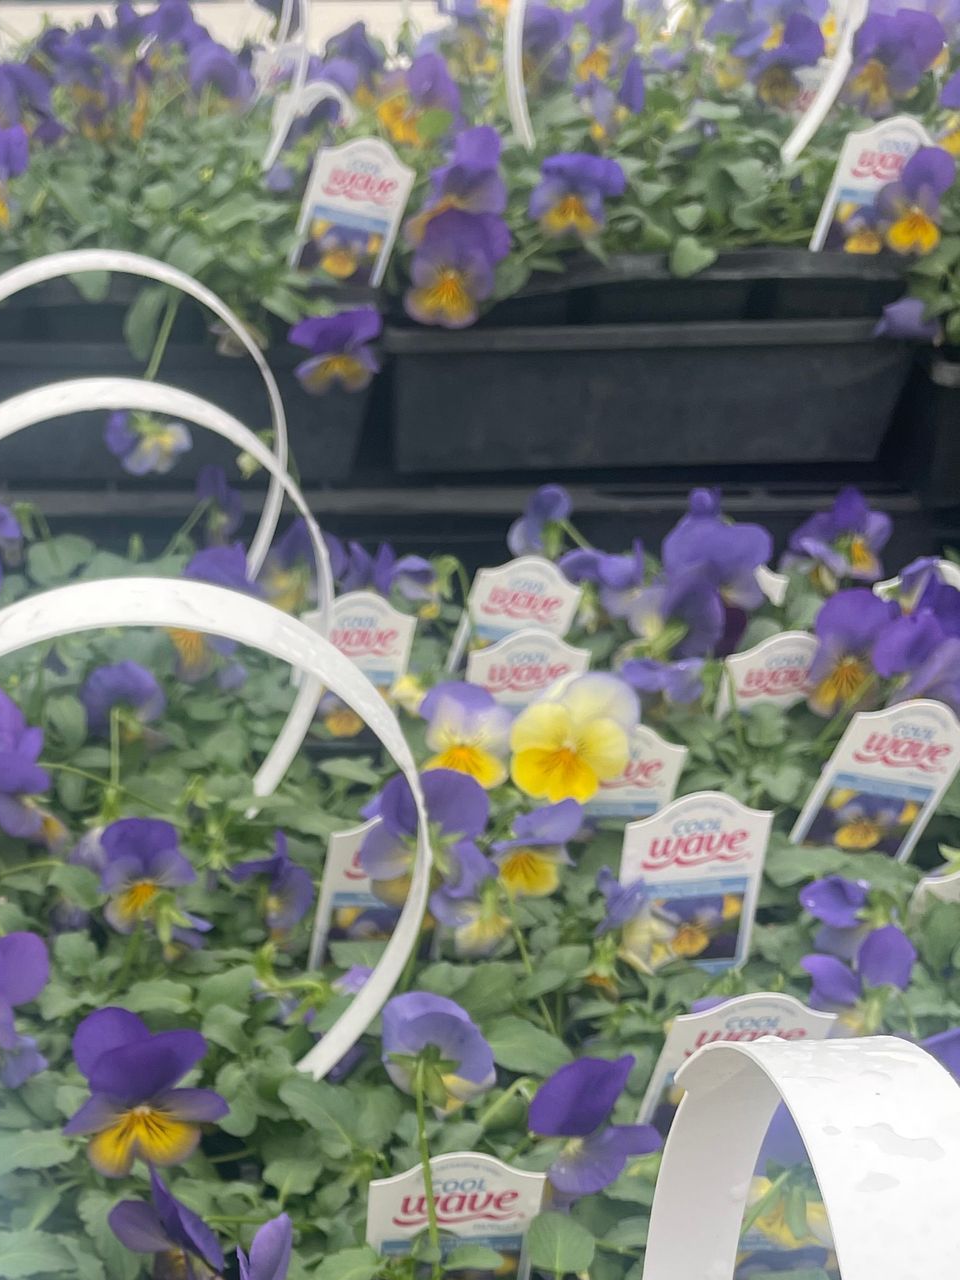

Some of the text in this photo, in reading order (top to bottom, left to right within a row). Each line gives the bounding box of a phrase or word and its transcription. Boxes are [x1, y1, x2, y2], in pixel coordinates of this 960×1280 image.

[864, 732, 952, 762] wave
[648, 829, 750, 858] wave
[400, 1188, 519, 1215] wave
